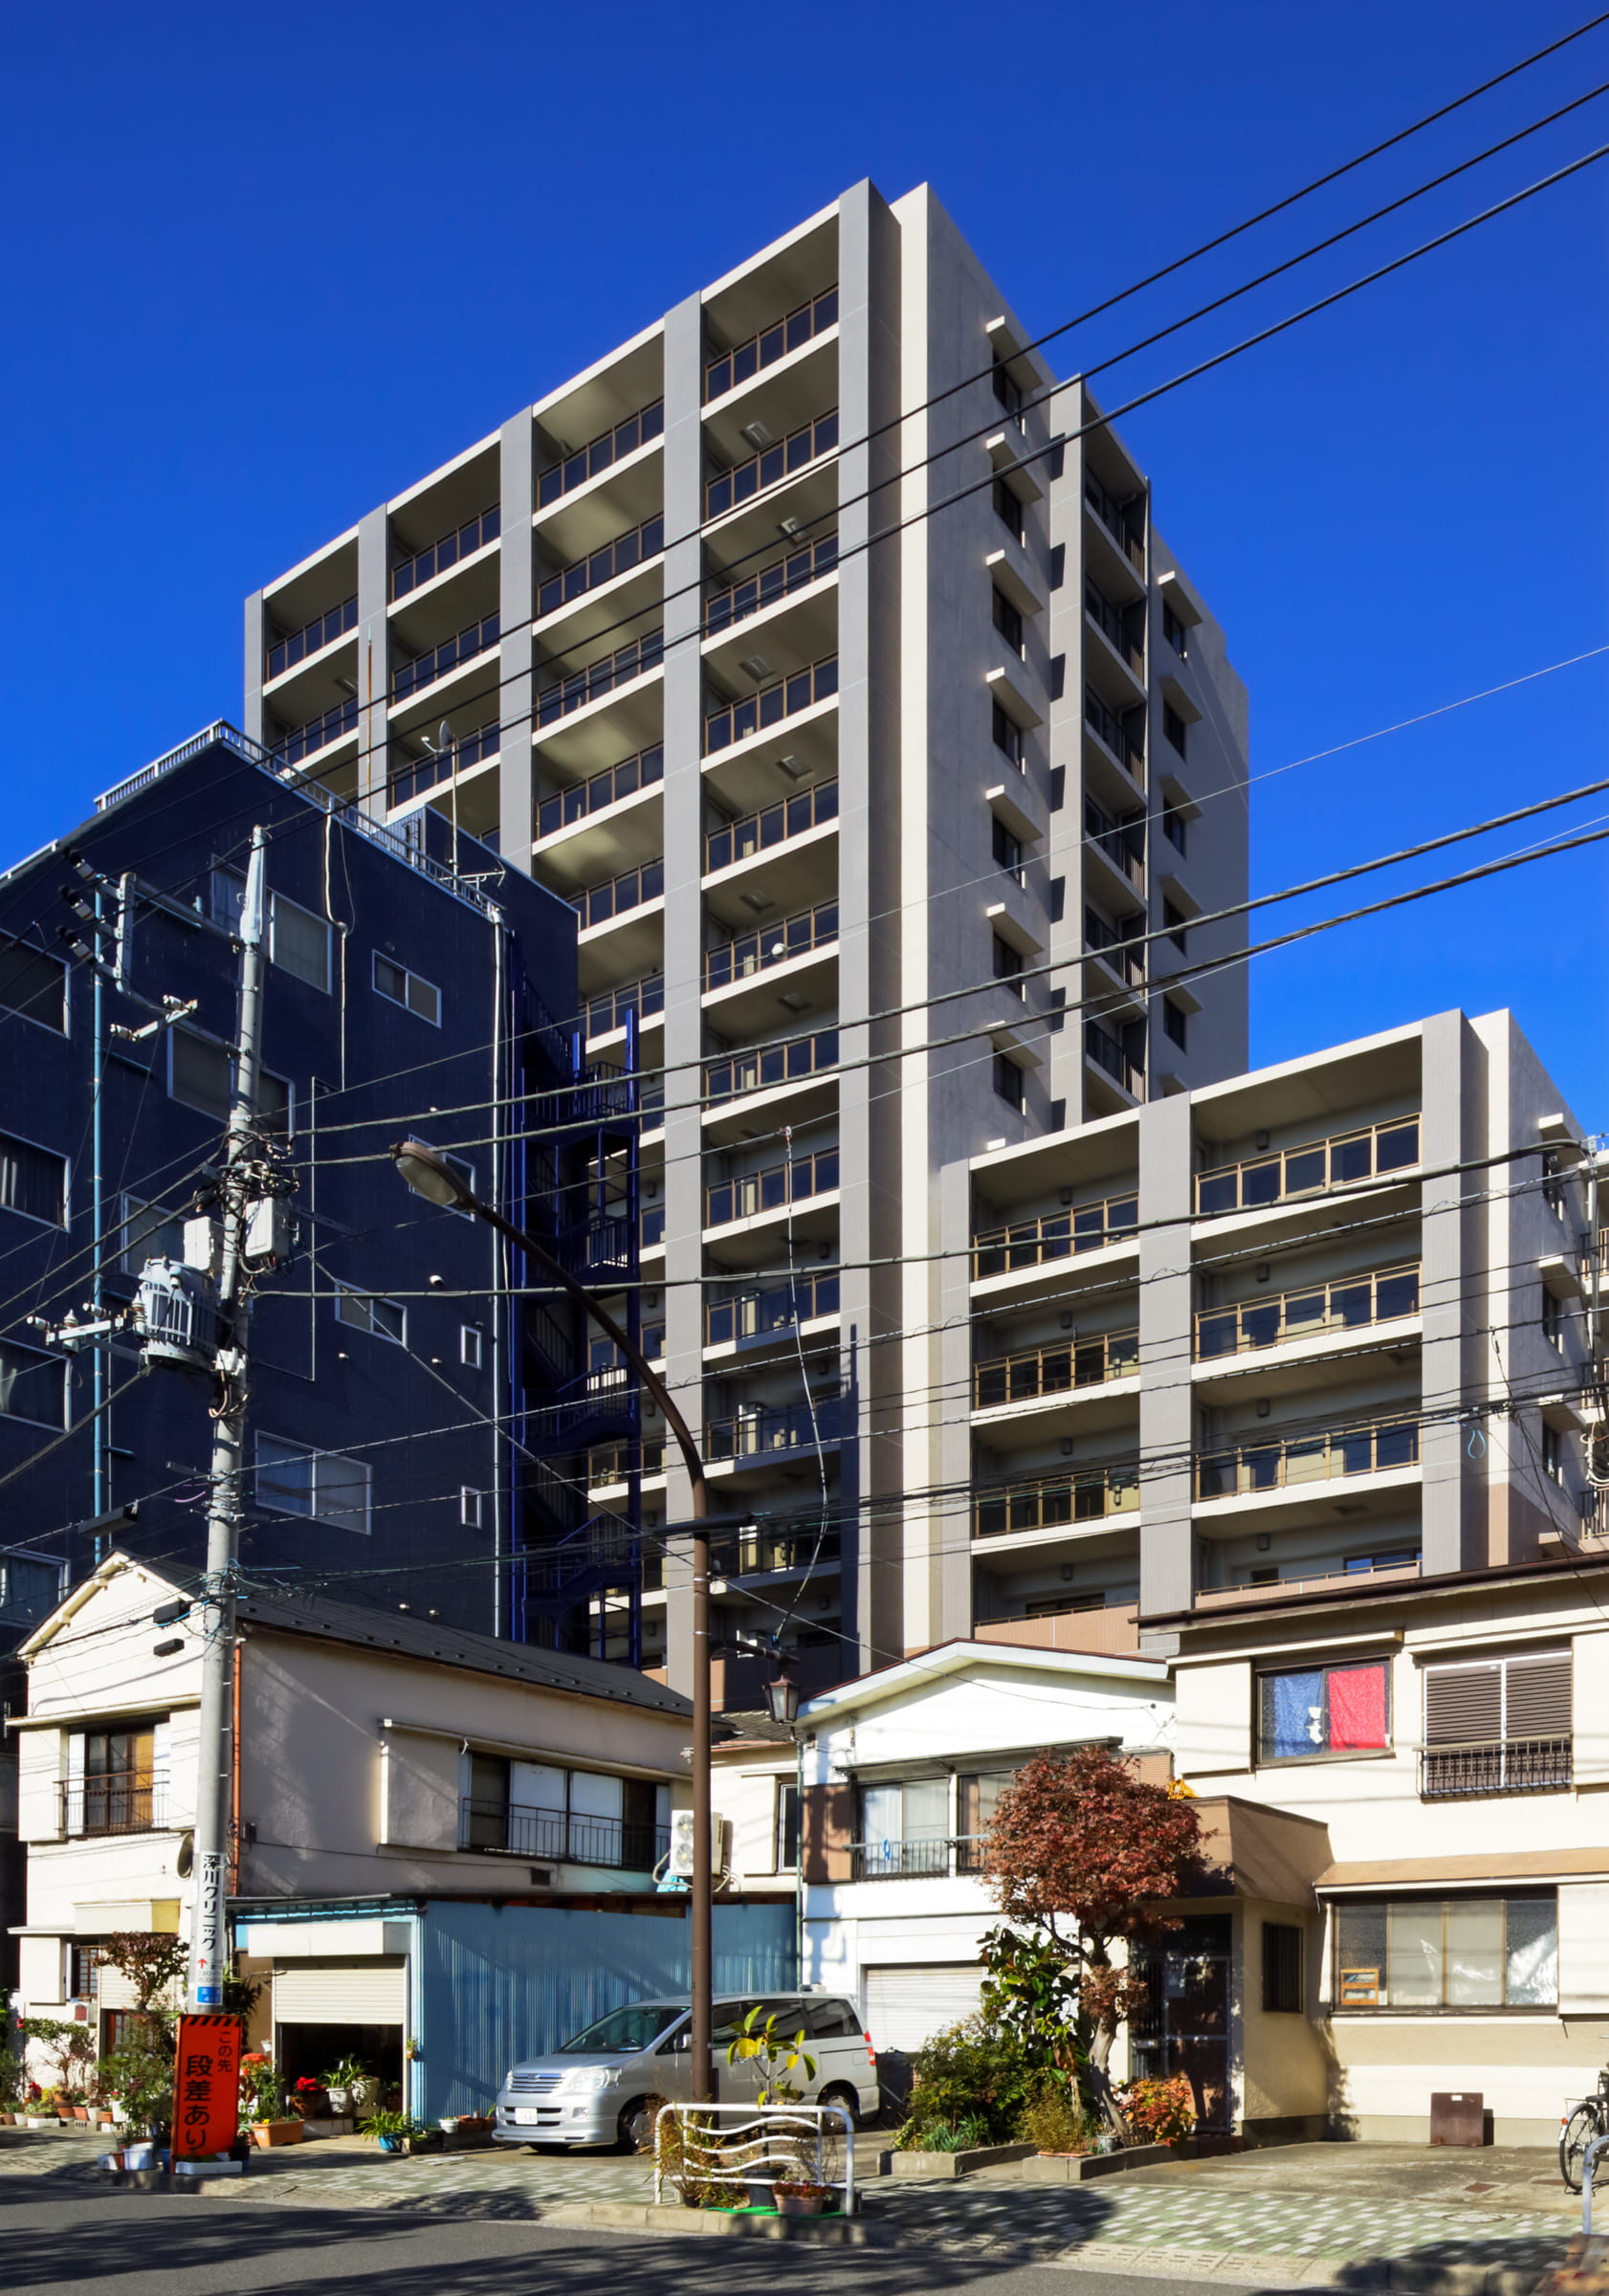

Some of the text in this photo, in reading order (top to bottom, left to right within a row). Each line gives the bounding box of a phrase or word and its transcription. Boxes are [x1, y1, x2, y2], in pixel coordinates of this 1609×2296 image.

[202, 1854, 220, 1952] 深川クリニック
[217, 2030, 233, 2073] この先
[184, 2054, 213, 2152] 段差あり
